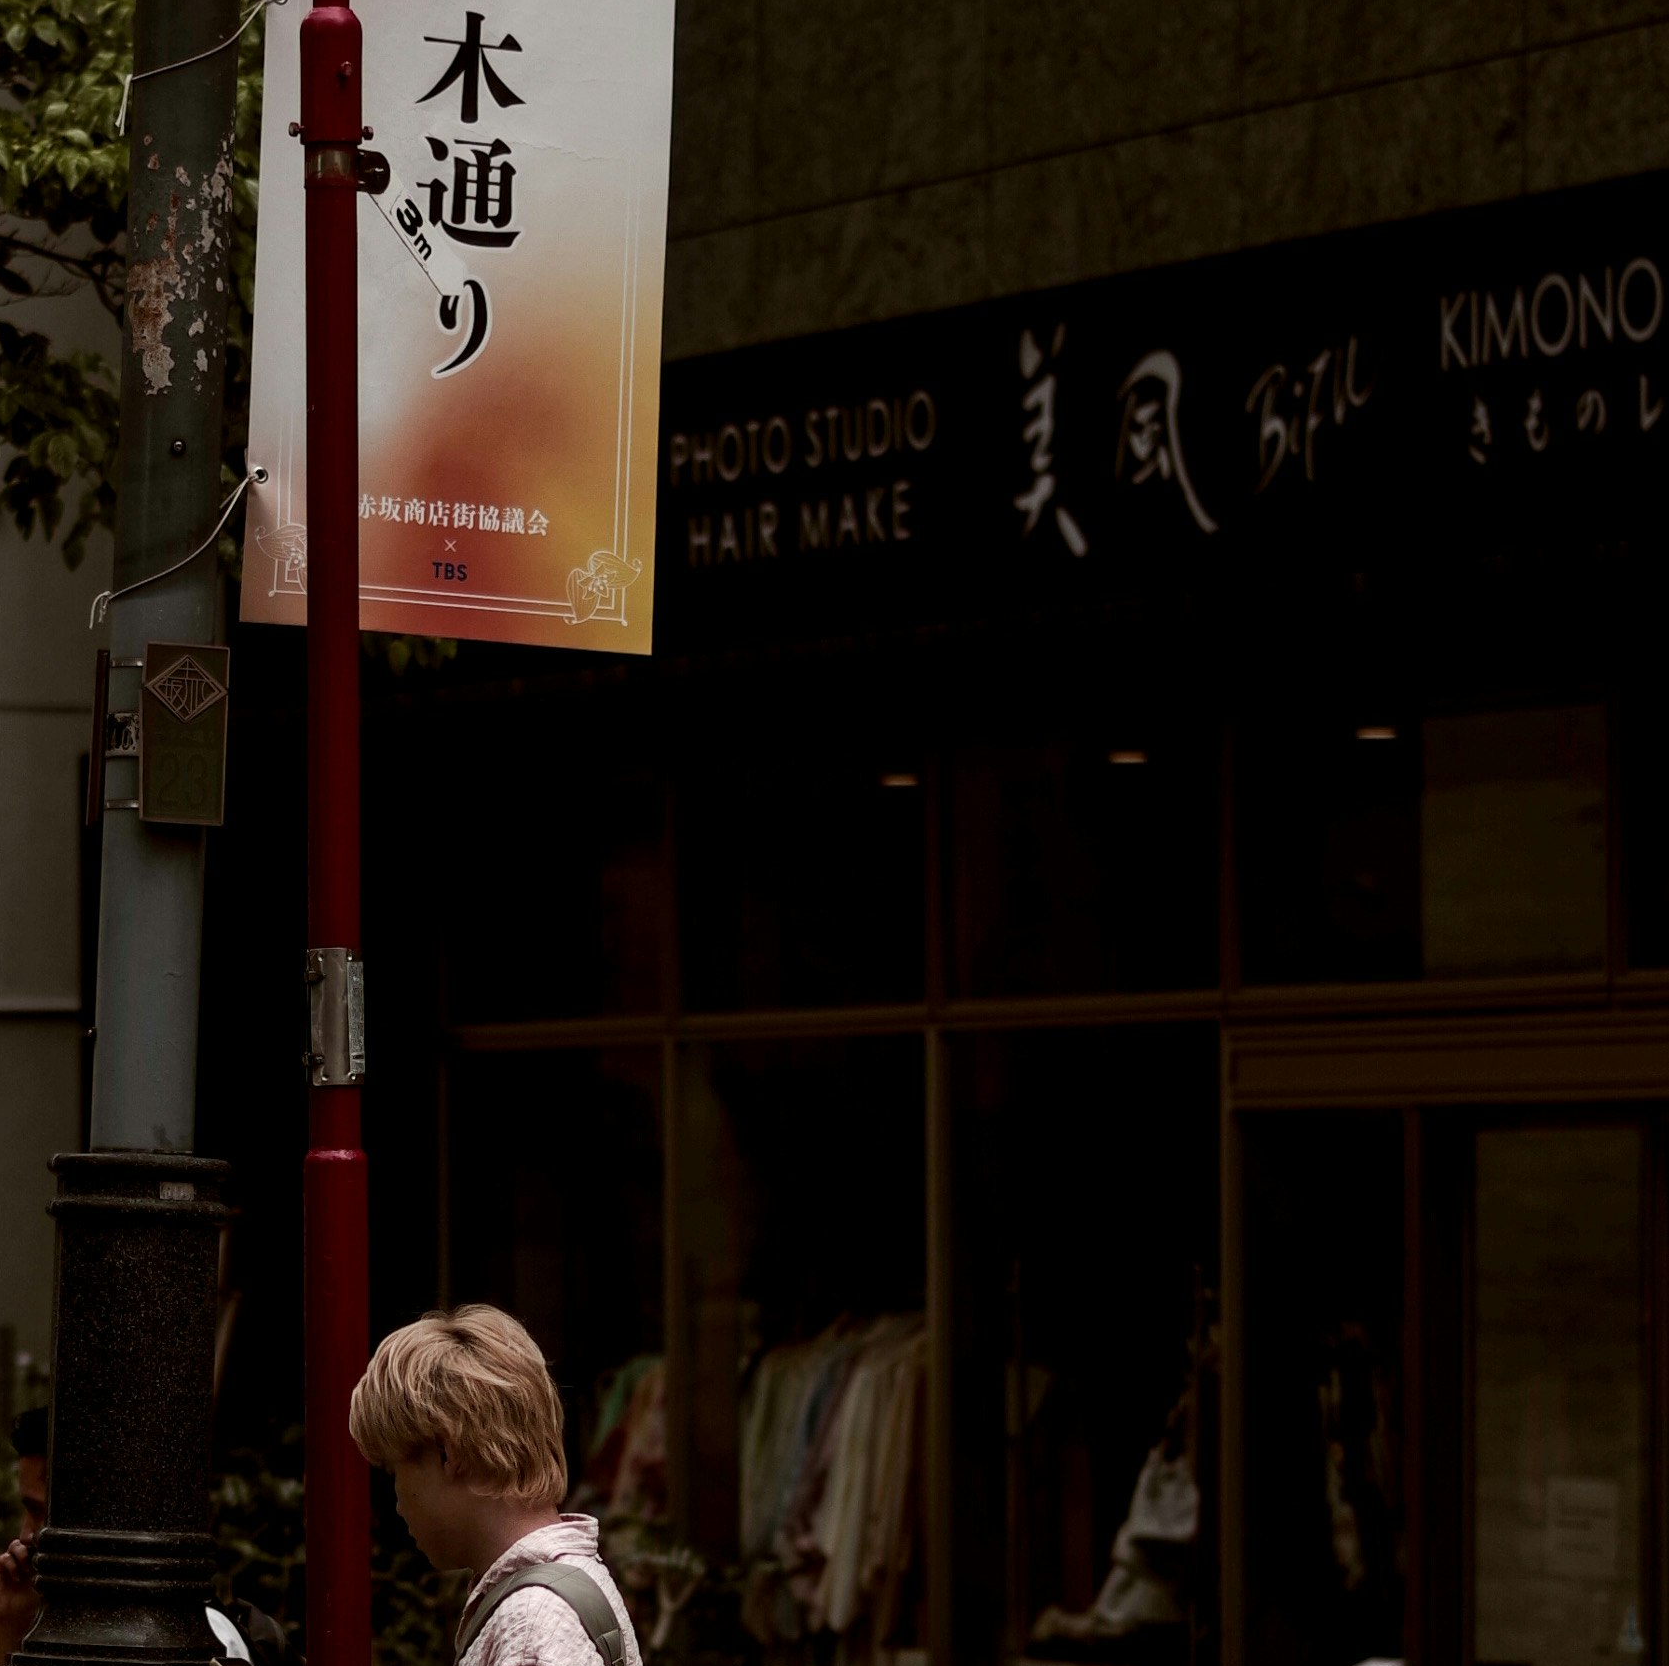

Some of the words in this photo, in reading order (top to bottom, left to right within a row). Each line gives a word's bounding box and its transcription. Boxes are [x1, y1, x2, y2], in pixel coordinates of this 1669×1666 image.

[395, 197, 434, 261] 3m
[1439, 255, 1665, 372] KIMONO
[668, 414, 794, 490] PHOTO
[804, 387, 938, 469] STUDIO
[358, 493, 550, 537] 赤坂商店街協議会
[687, 497, 781, 571] HAIR
[798, 477, 913, 554] MAKE
[432, 561, 468, 582] TBS
